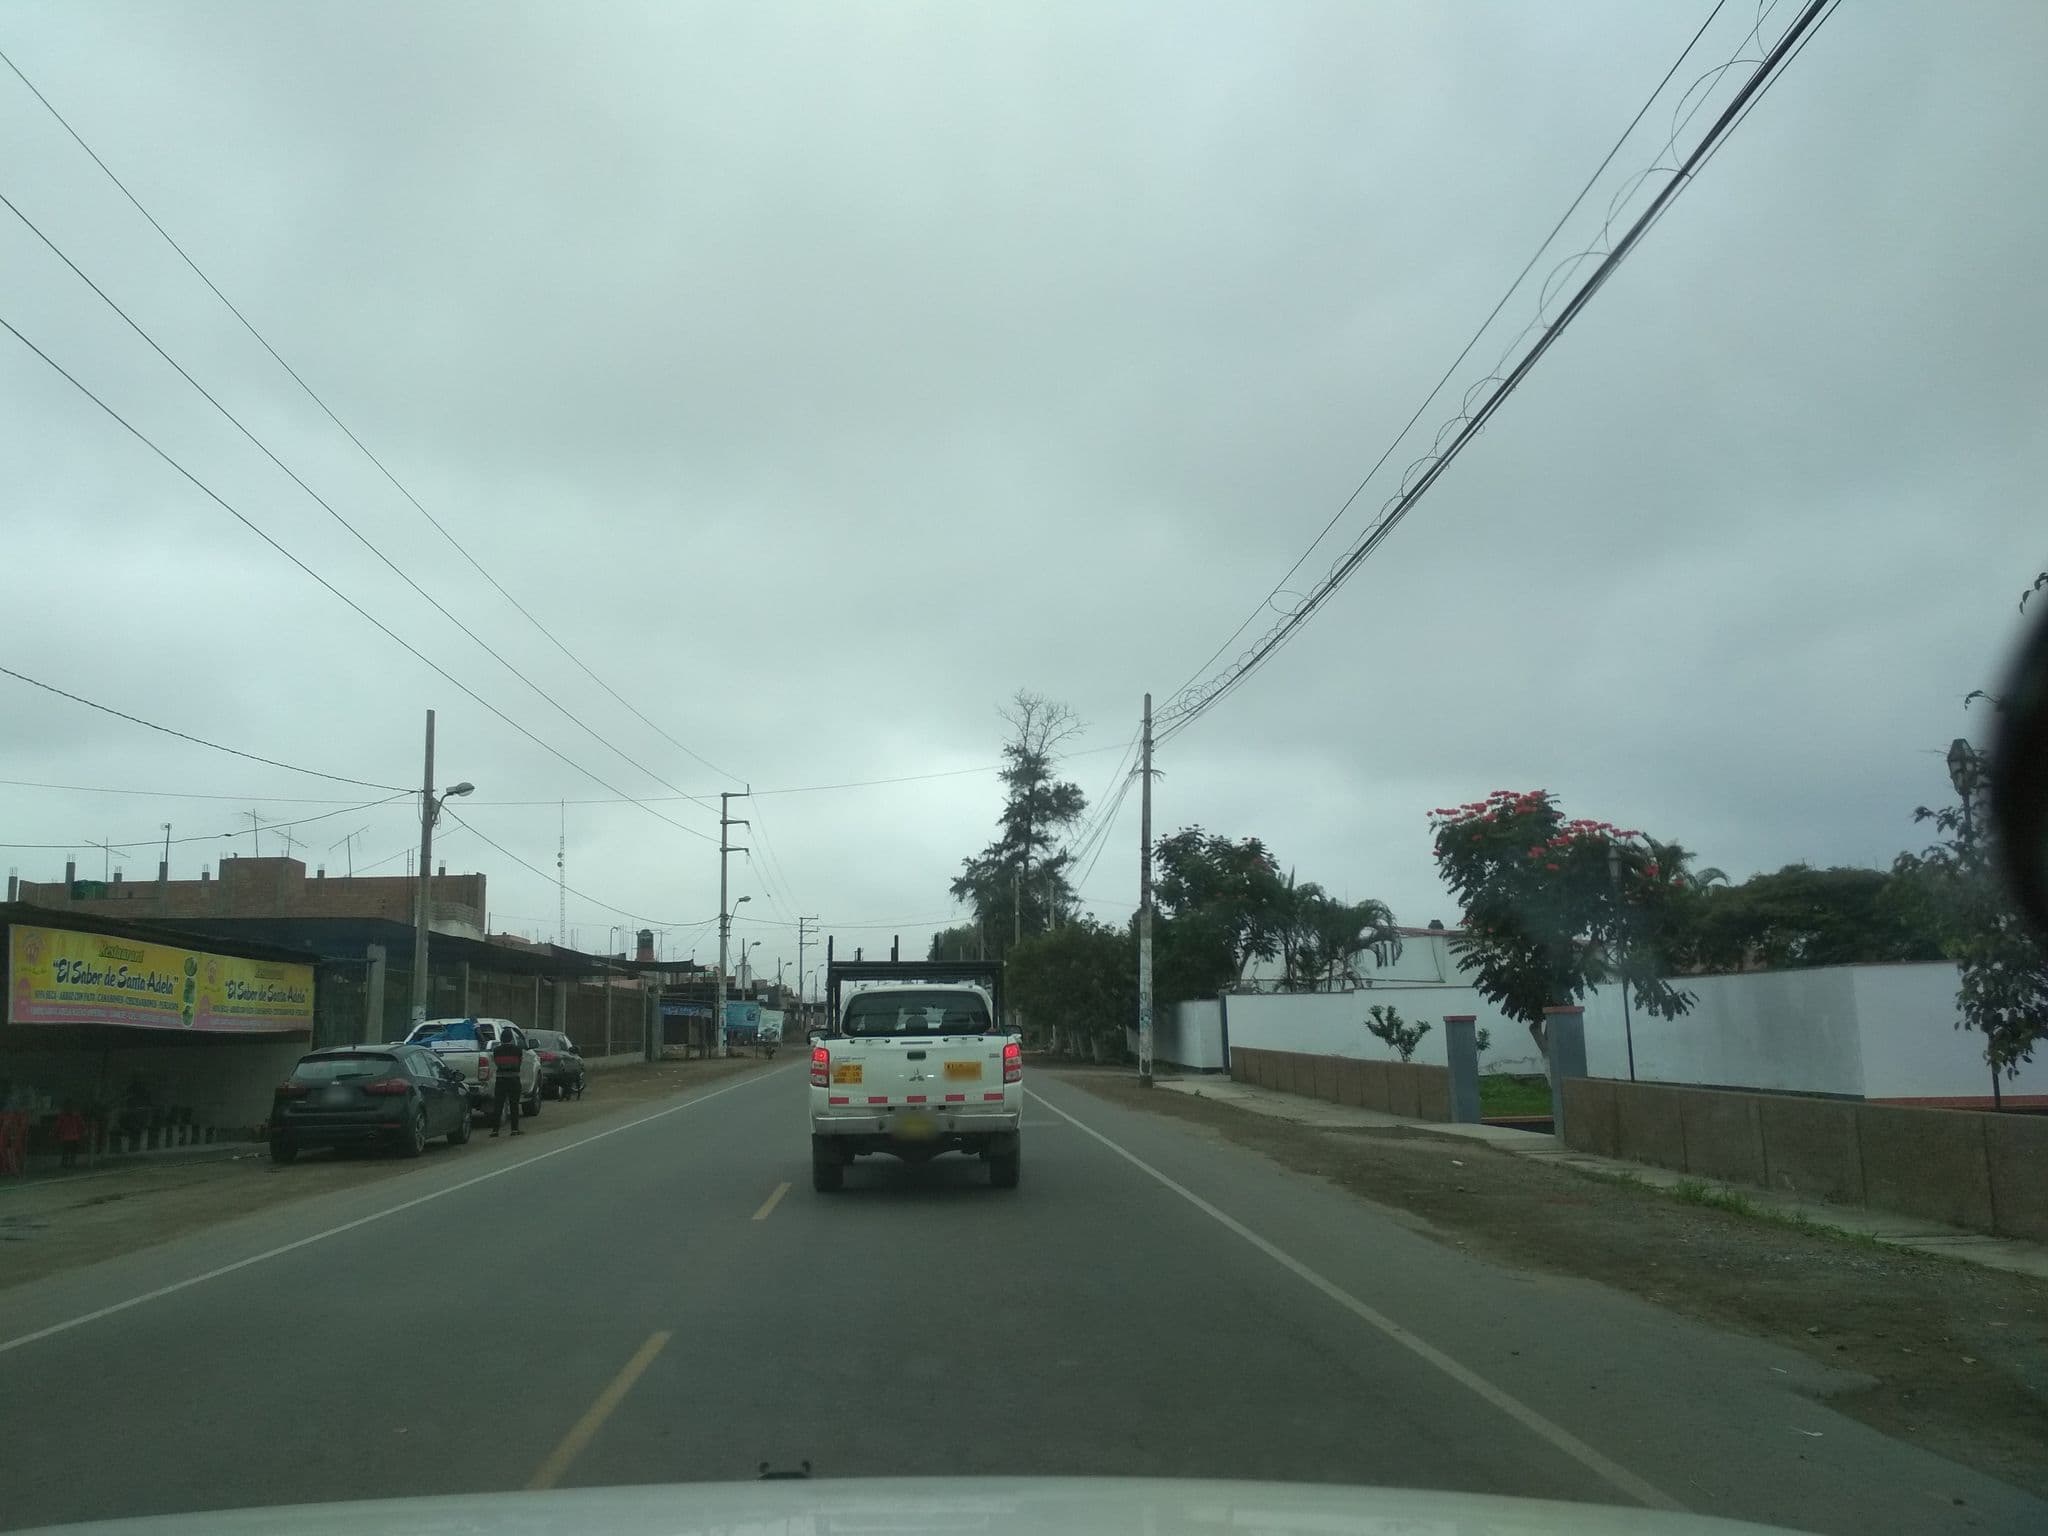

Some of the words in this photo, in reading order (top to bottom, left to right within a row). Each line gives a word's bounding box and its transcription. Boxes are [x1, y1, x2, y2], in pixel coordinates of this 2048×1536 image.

[71, 960, 102, 985] Sabor
[104, 966, 116, 987] de
[118, 966, 145, 991] Santa
